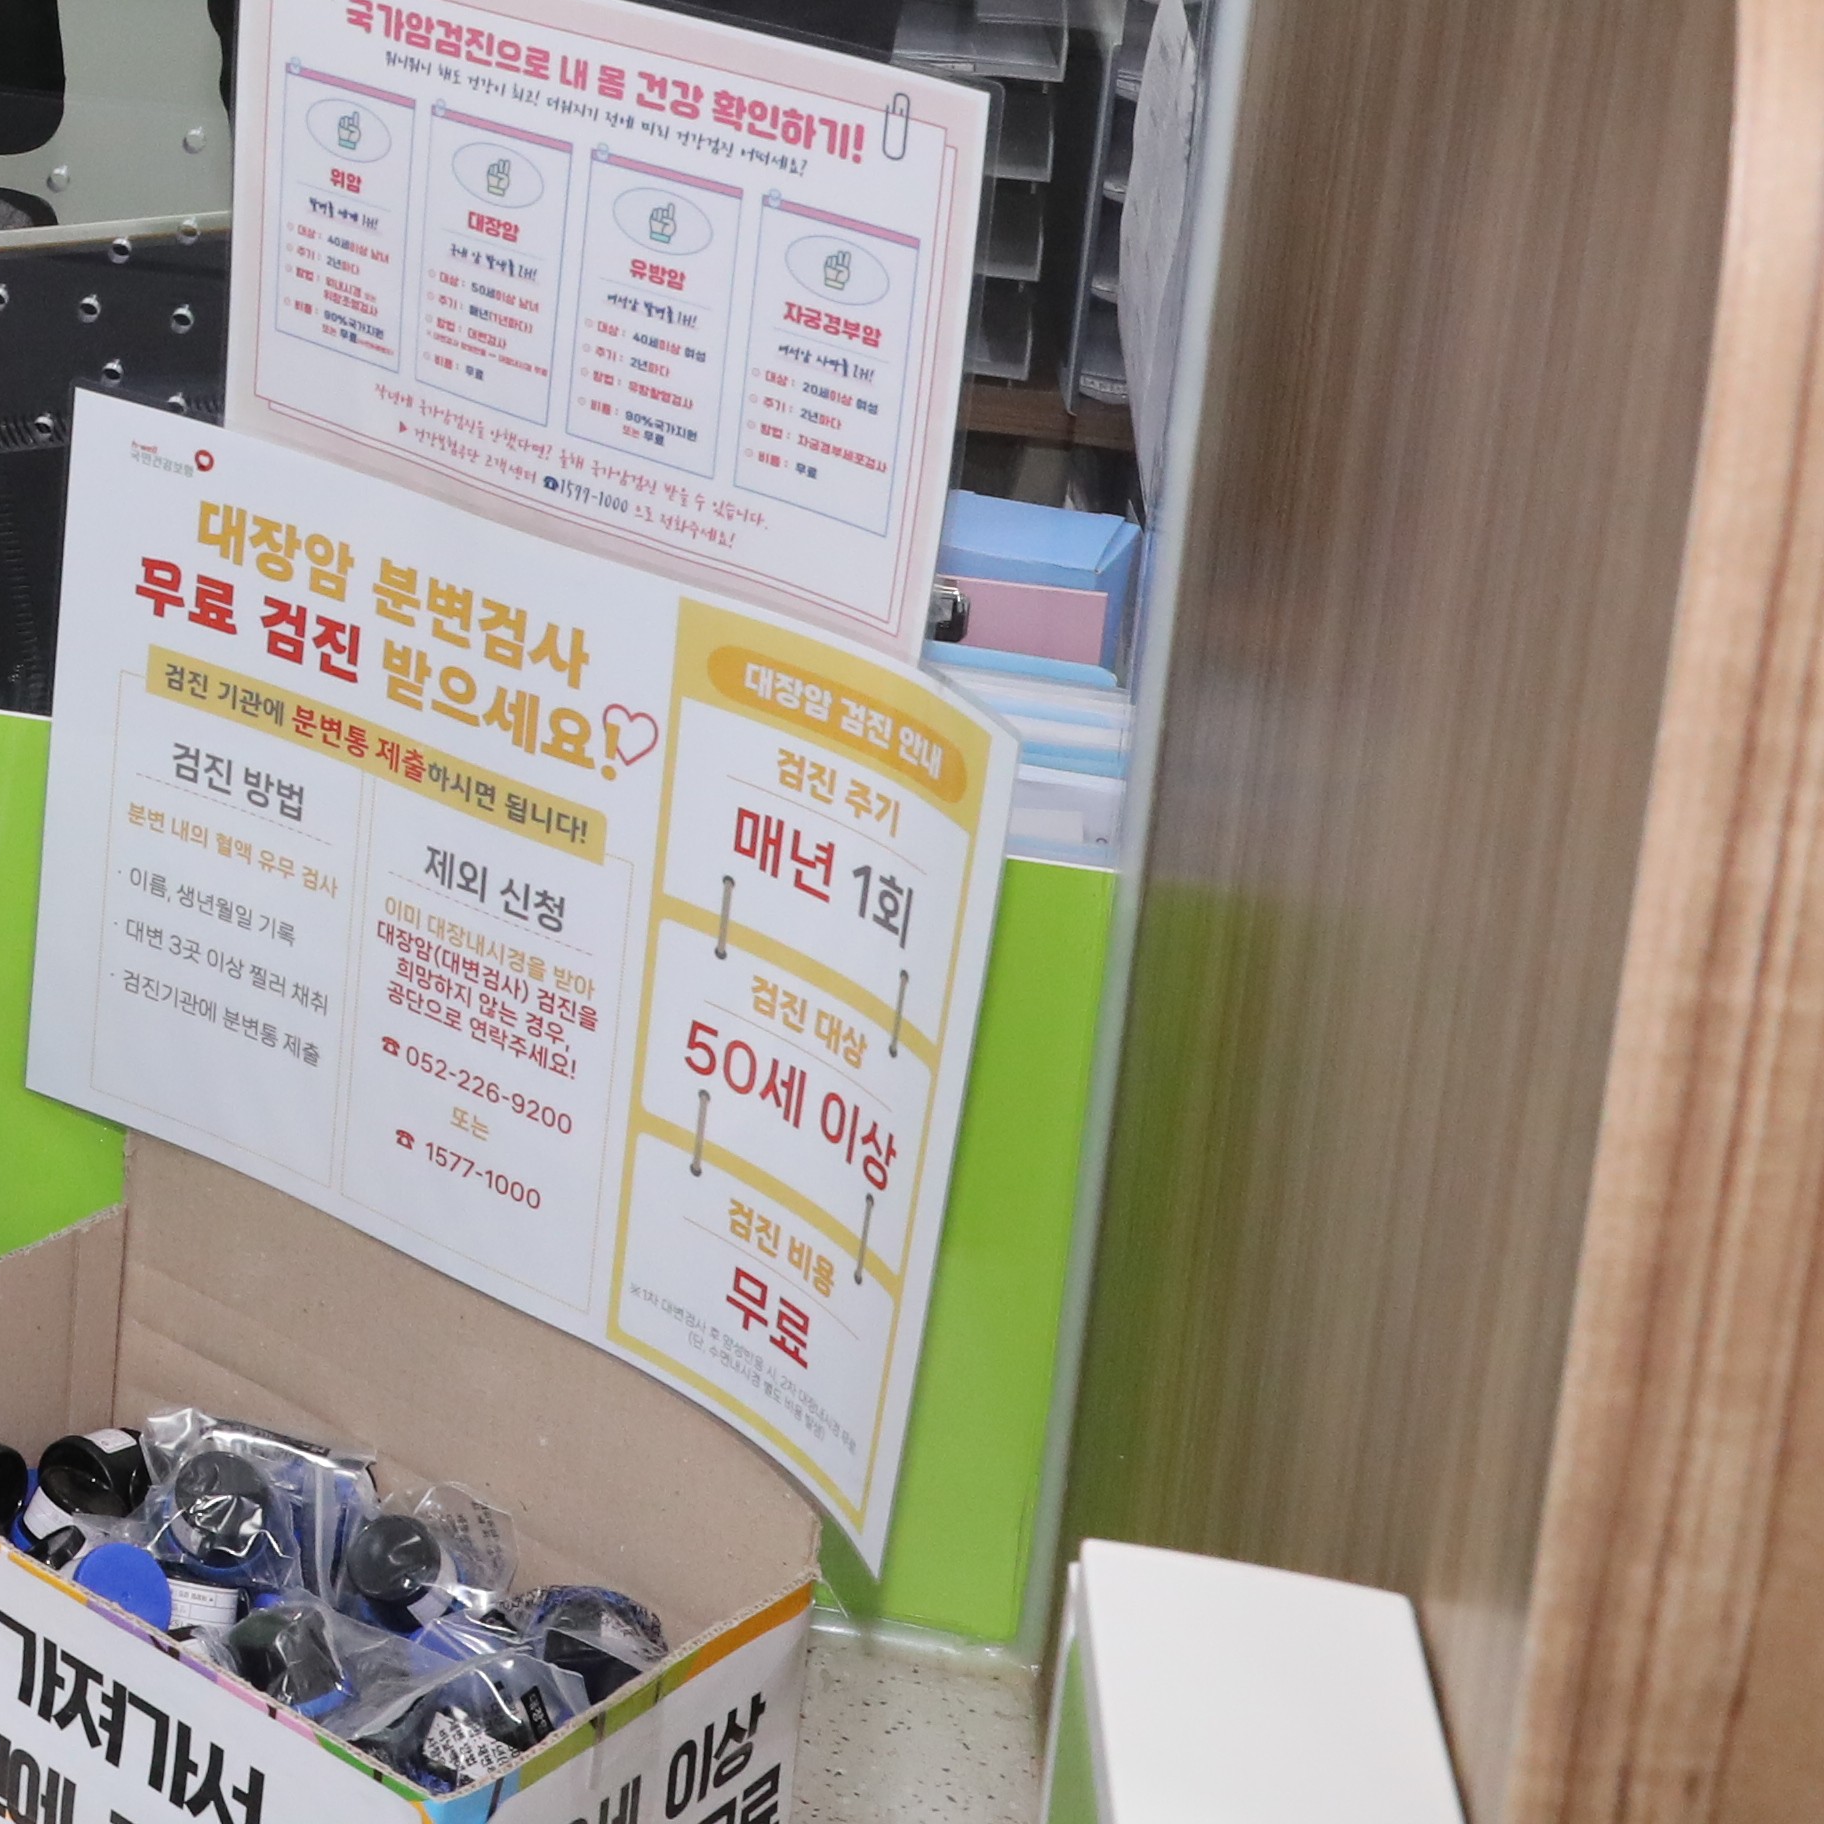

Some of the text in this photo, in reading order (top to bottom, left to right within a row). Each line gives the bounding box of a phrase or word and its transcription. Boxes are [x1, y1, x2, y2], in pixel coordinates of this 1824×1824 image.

[560, 56, 588, 90] 내
[598, 65, 625, 100] 몸
[637, 72, 704, 119] 건강
[713, 90, 864, 164] 확인하기!
[331, 169, 361, 193] 위암
[468, 211, 519, 242] 대장암
[630, 259, 685, 290] 유방암
[784, 302, 881, 348] 자궁경부암
[198, 501, 589, 689] 대장암 분변검사
[136, 557, 621, 780] 무료 검진 받으세요!
[165, 664, 587, 843] 검진 기관에 분변통 제출하시면 됩니다!
[745, 663, 943, 779] 대장암 검진 안내
[173, 743, 303, 821] 검진 방법
[778, 749, 900, 837] 검진 주기
[130, 868, 295, 946] 이름, 생년월일 기록
[425, 847, 564, 932] 제외 신청
[734, 808, 913, 949] 매년 1회
[378, 925, 597, 1030] 대장암(대변검사) 검진을
[383, 897, 595, 997] 이미 대장내시경을 받아
[124, 970, 319, 1066] 검진기관에 분변통 제출
[388, 982, 576, 1079] 공단으로 연락주세요!
[752, 976, 867, 1068] 검진 대상
[407, 1046, 571, 1134] 052-226-9200
[451, 1107, 488, 1141] 또는
[685, 1020, 896, 1190] 50세 이상
[426, 1143, 540, 1209] 1577-1000
[729, 1199, 834, 1297] 검진 비용
[726, 1267, 809, 1369] 무료
[666, 1692, 766, 1819] 이상
